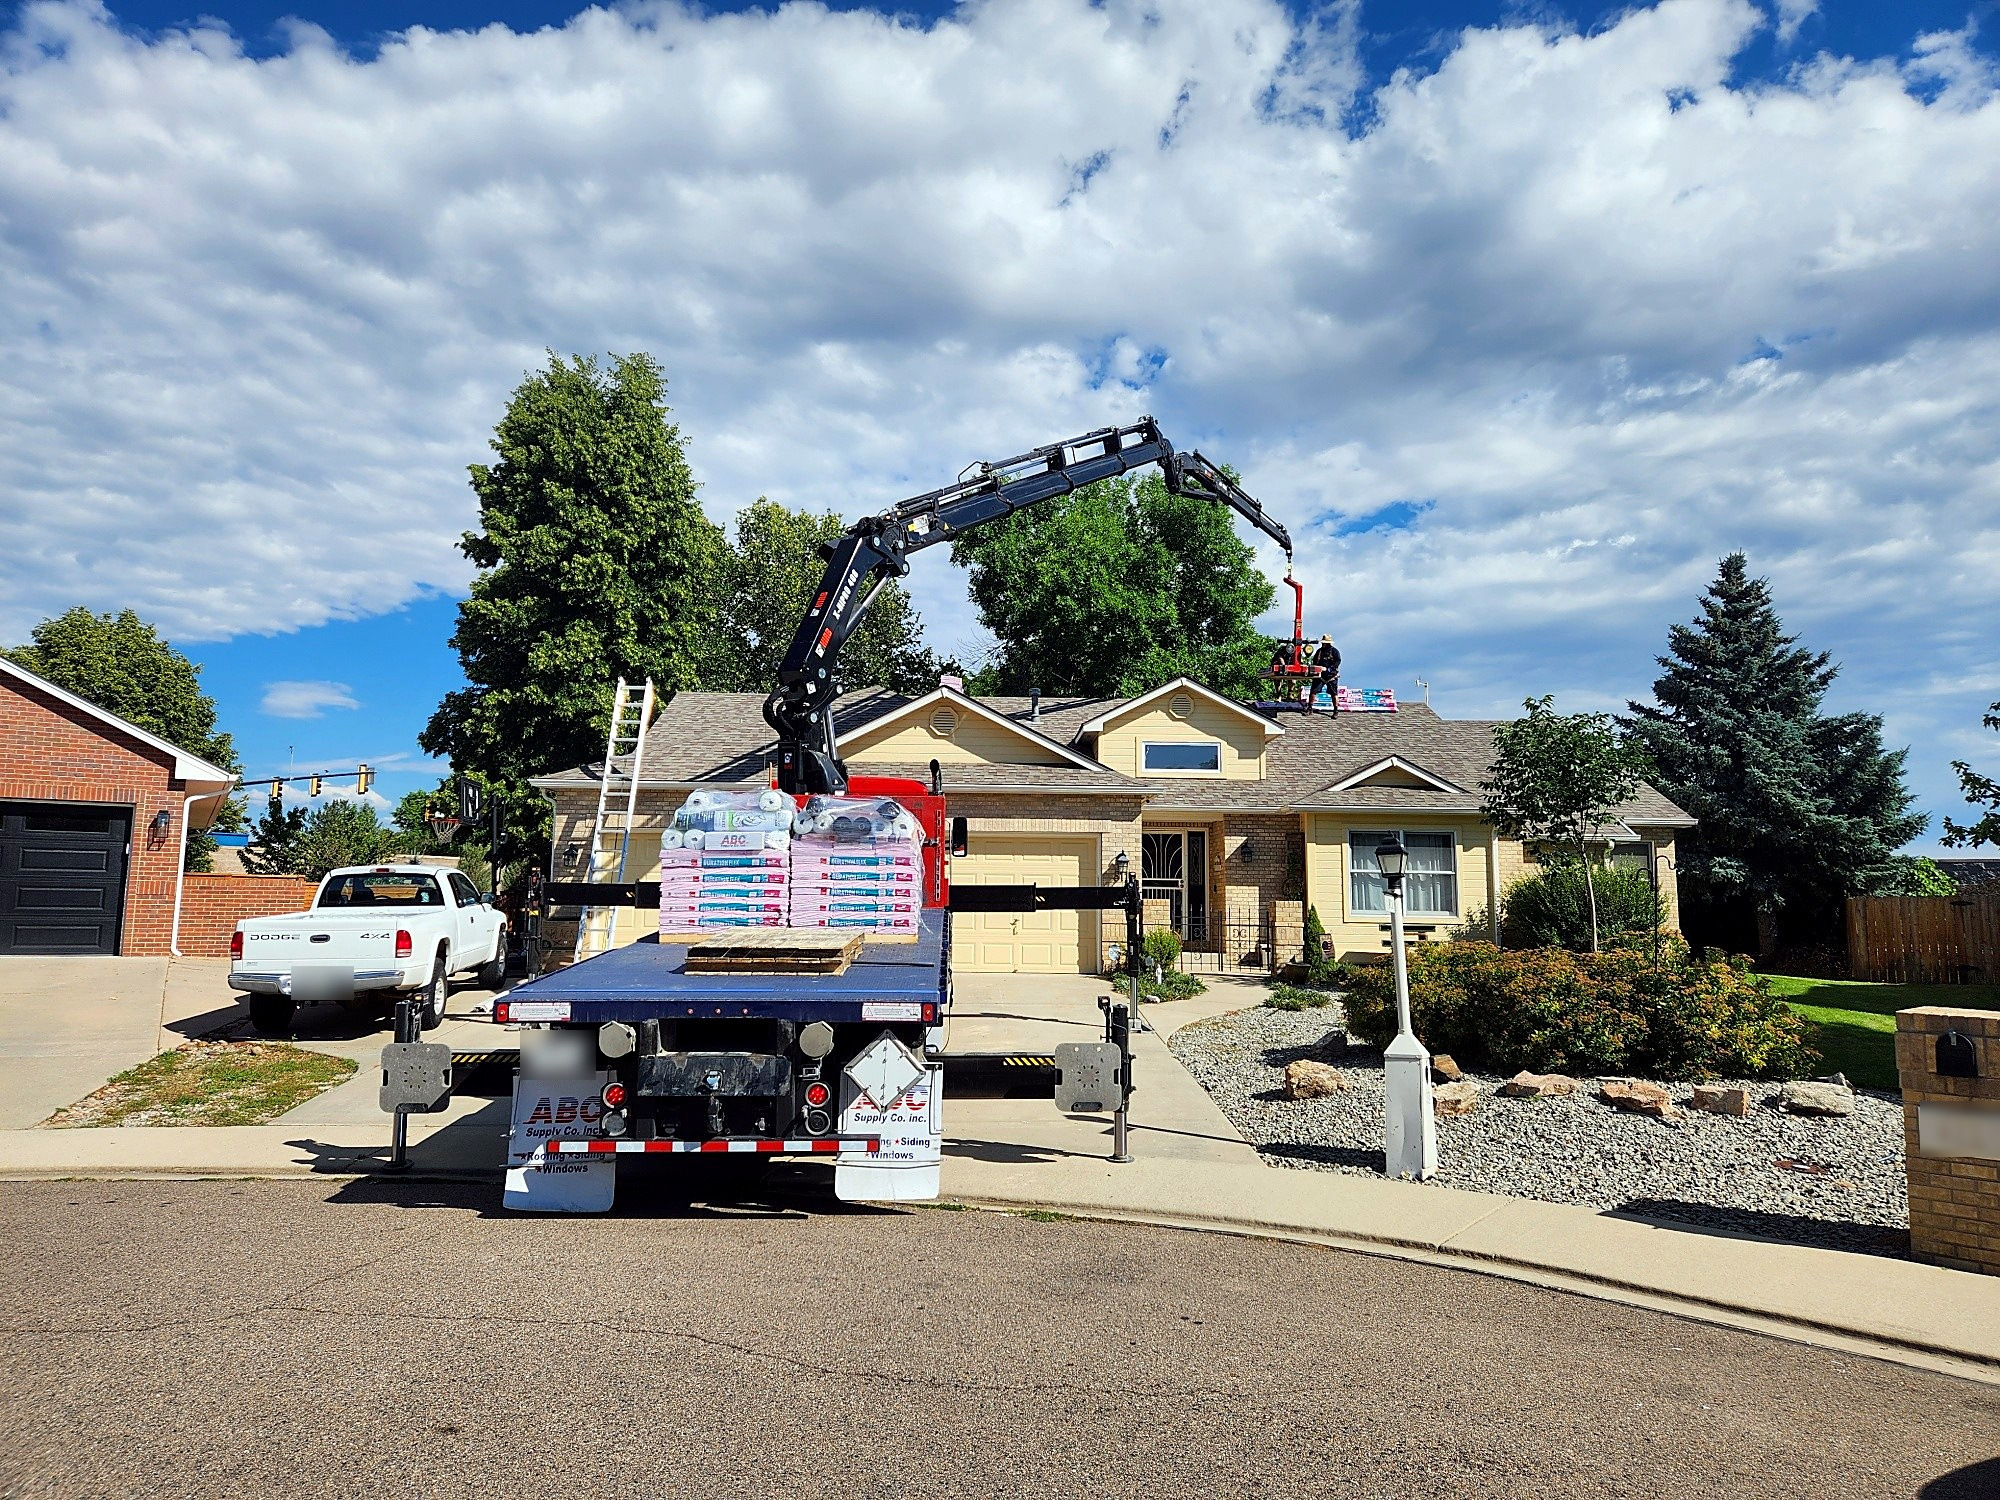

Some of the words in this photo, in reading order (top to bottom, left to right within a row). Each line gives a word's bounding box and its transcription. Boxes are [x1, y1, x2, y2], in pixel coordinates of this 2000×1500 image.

[720, 834, 748, 845] ABC
[522, 1096, 601, 1124] ABC
[854, 1112, 888, 1124] Supply
[890, 1113, 906, 1123] Co.
[908, 1113, 927, 1123] inc.
[526, 1126, 562, 1138] Supply
[564, 1126, 580, 1136] Co.
[900, 1137, 930, 1148] Siding
[527, 1152, 565, 1162] Roofing
[871, 1151, 914, 1160] Windows
[542, 1164, 588, 1174] Windows
